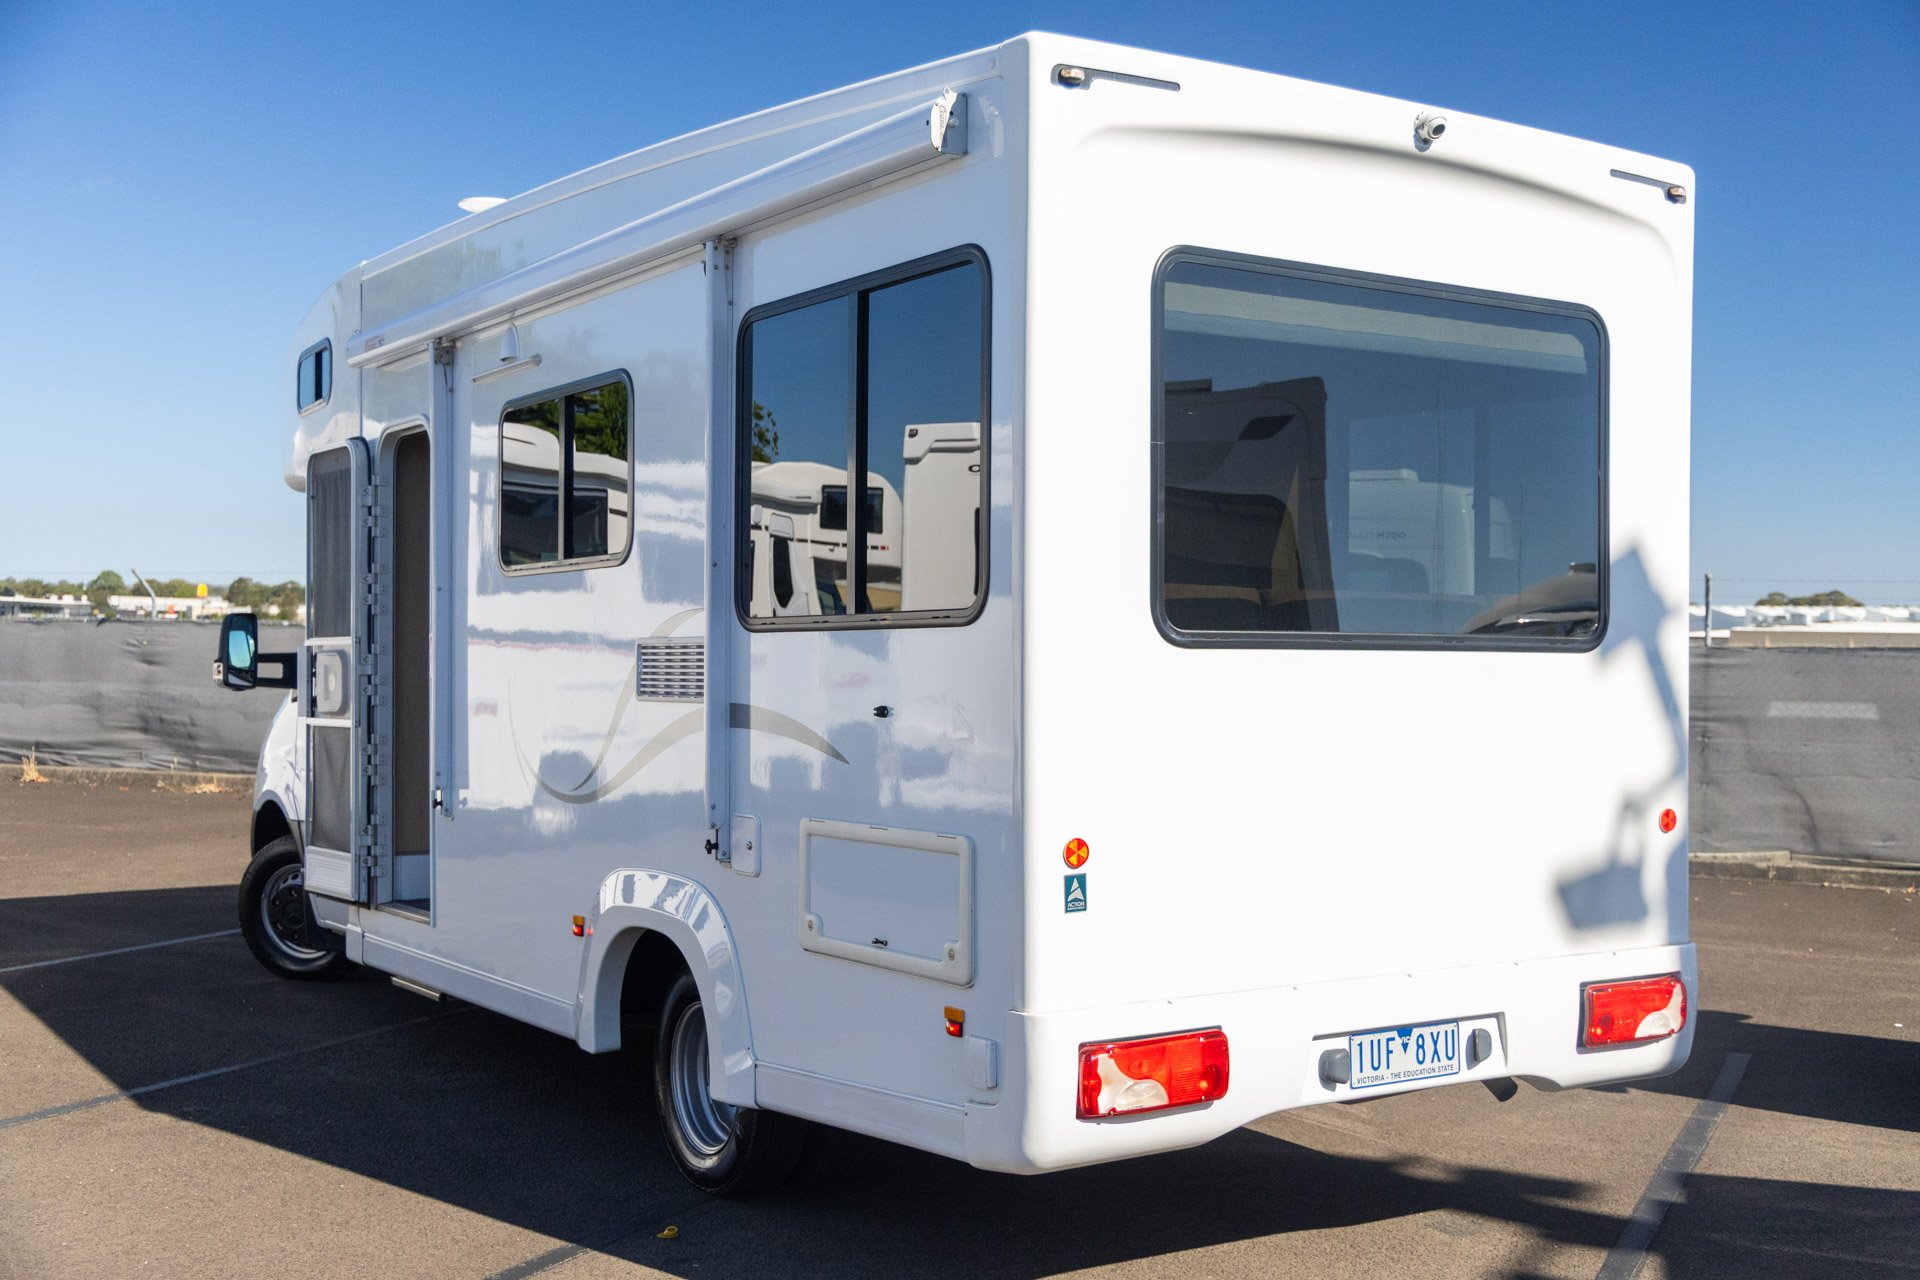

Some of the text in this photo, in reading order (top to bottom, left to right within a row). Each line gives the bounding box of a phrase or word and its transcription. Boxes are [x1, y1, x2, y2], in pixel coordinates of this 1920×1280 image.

[1401, 1036, 1411, 1044] VIC
[1357, 1029, 1455, 1073] 1UF 8XU
[1356, 1074, 1385, 1085] VICTORIA
[1390, 1072, 1402, 1080] THE
[1403, 1067, 1436, 1077] EDUCATION
[1437, 1064, 1454, 1072] STATE
